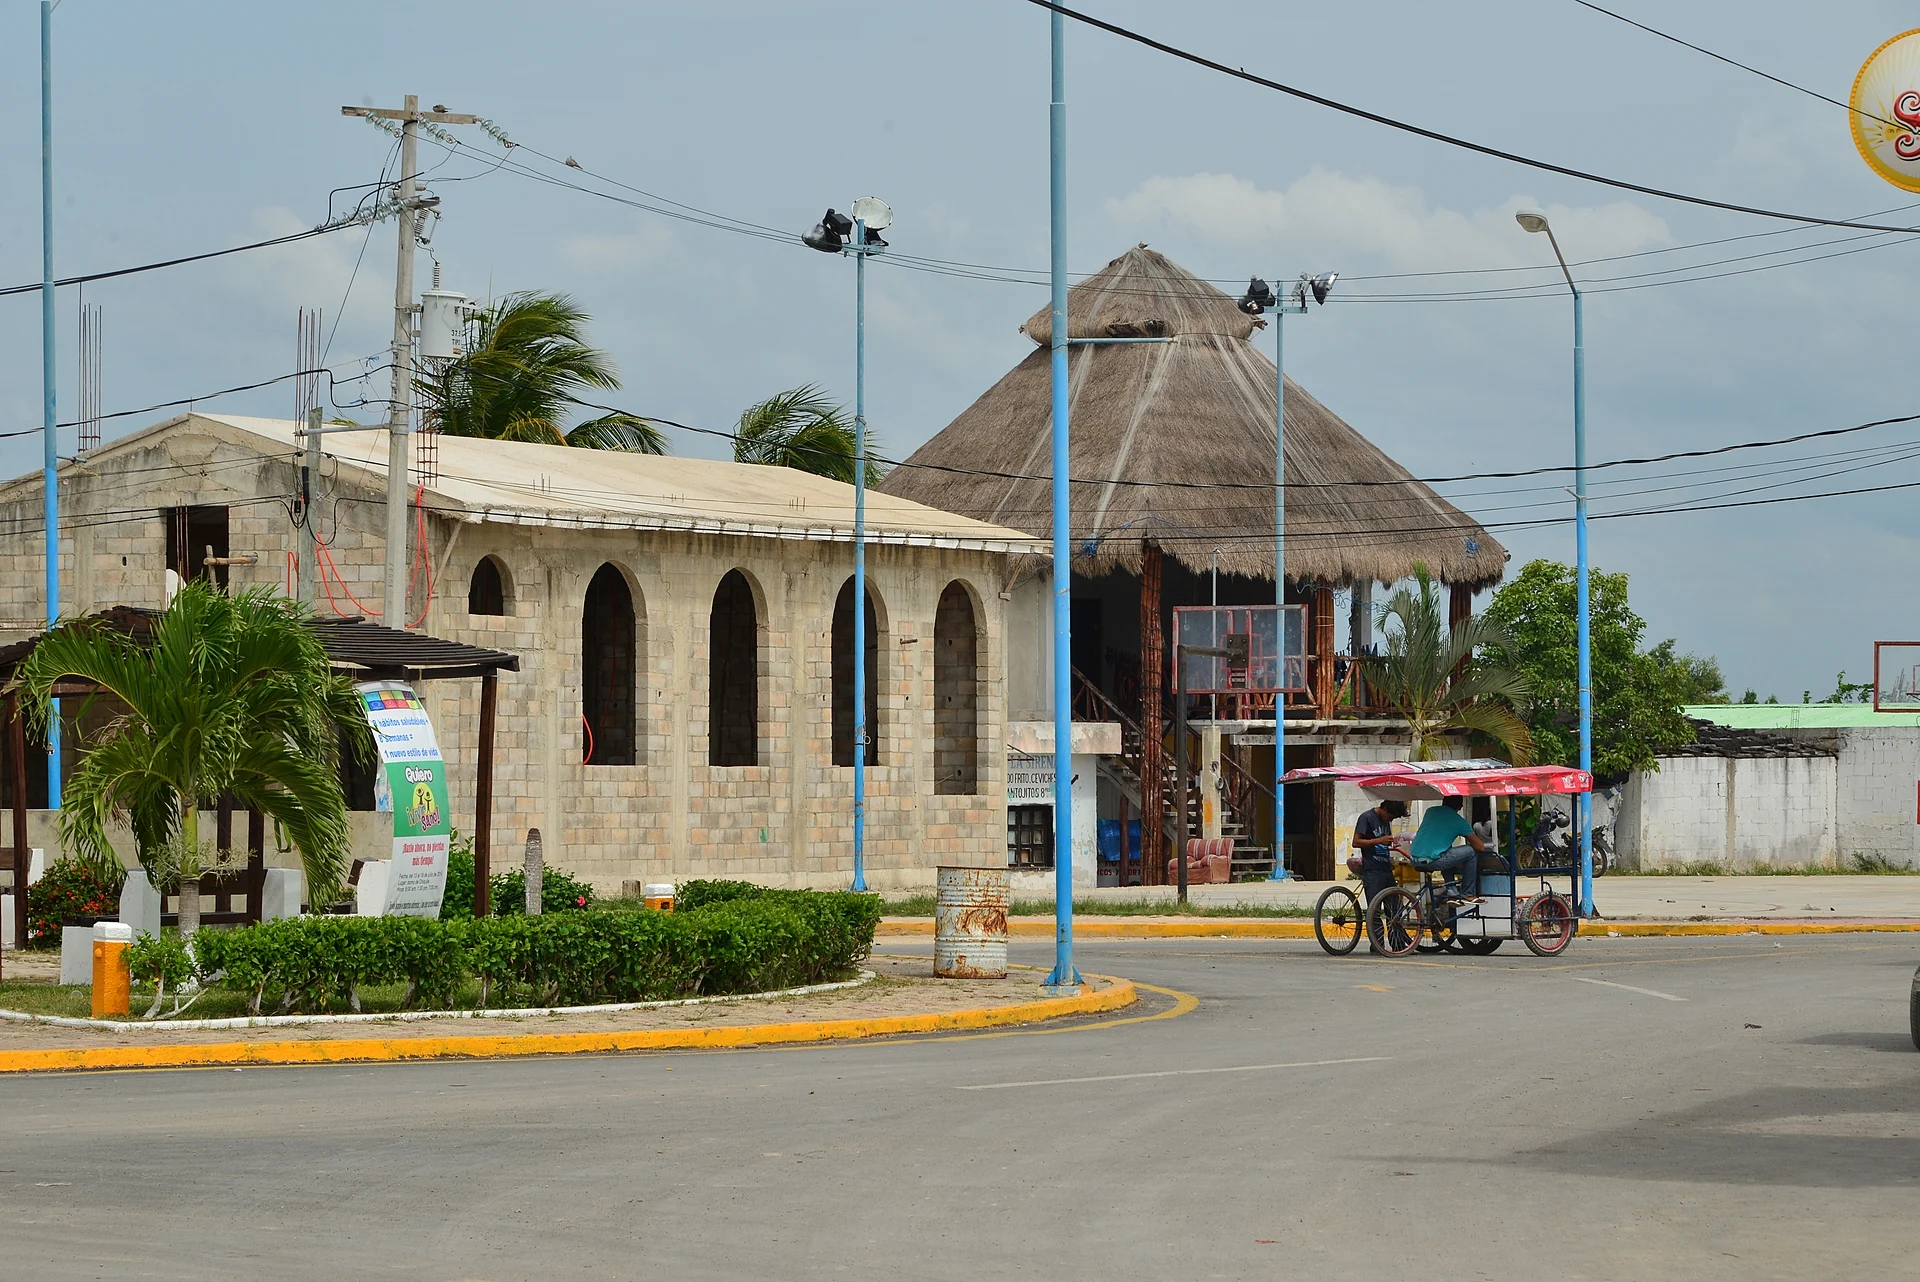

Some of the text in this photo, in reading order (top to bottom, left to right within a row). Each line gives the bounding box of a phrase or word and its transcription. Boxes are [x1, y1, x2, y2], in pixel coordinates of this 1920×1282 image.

[378, 718, 400, 728] hábitos
[400, 716, 426, 726] saludables
[406, 748, 421, 757] estilo
[422, 748, 428, 756] de
[428, 747, 438, 756] vida
[1010, 755, 1056, 769] LA SIREN
[405, 765, 433, 784] Quiero
